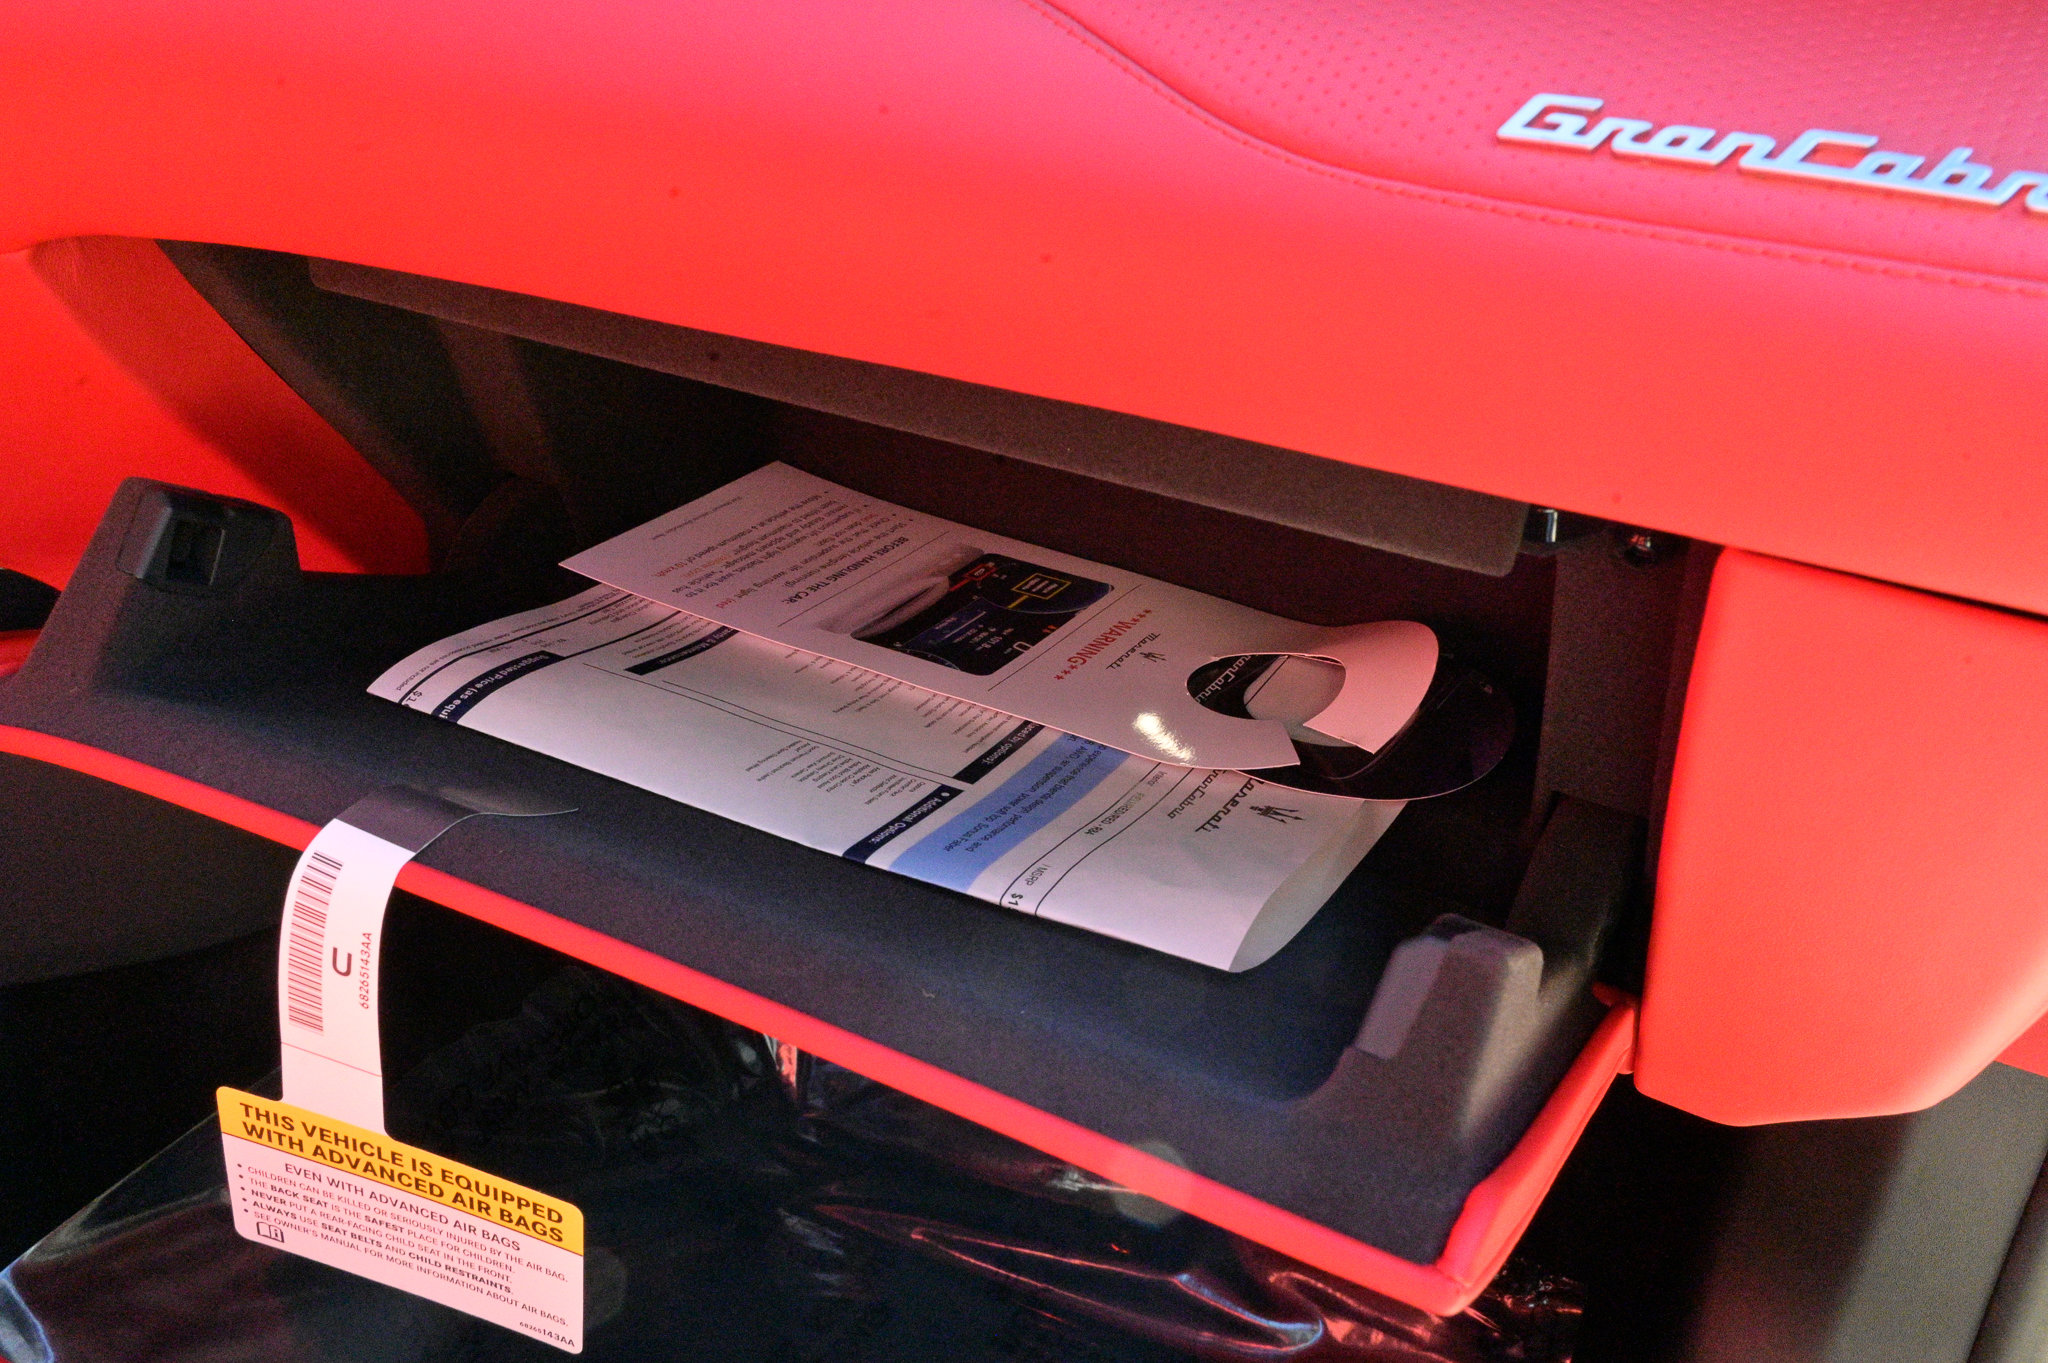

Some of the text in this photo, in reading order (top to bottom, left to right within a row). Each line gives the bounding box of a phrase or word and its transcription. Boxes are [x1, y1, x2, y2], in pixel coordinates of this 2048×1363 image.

[823, 554, 877, 582] HANDLING
[871, 536, 910, 556] BEFORE
[804, 580, 830, 592] THE
[500, 653, 550, 677] Suggested
[1106, 632, 1160, 669] Maserati
[460, 687, 479, 701] (as
[474, 672, 503, 689] Price
[1006, 735, 1024, 743] by
[900, 797, 943, 823] Additional
[358, 932, 372, 1010] 68265143AA
[239, 1100, 563, 1225] THIS VEHICLE IS EQUIPPED
[241, 1119, 563, 1243] WITH ADVANCED AIR BAGS
[247, 1164, 568, 1283] CHILDREN CAN BE KILLED OR SERIOUSLY INJURED BY THE AIR BAG.
[250, 1176, 267, 1189] THE
[270, 1183, 299, 1200] BACK
[302, 1193, 328, 1209] SEAT
[330, 1203, 340, 1213] IS
[343, 1207, 361, 1220] THE
[364, 1214, 403, 1234] SAFEST
[407, 1228, 437, 1246] PLACE
[440, 1240, 460, 1253] FOR
[251, 1198, 297, 1221] ALWAYS
[299, 1214, 318, 1227] USE
[321, 1221, 348, 1237] SEAT
[350, 1230, 382, 1248] BELTS
[384, 1242, 405, 1256] AND
[408, 1250, 441, 1269] CHILD
[284, 1161, 520, 1252] EVEN WITH ADVANCED AIR BAGS
[250, 1187, 512, 1284] NEVER PUT A REAR-FACING CHILD SEAT IN THE FRONT.
[254, 1210, 568, 1327] SEE OWNER'S MANUAL FOR MORE INFORMATION ABOUT AIR BAGS.
